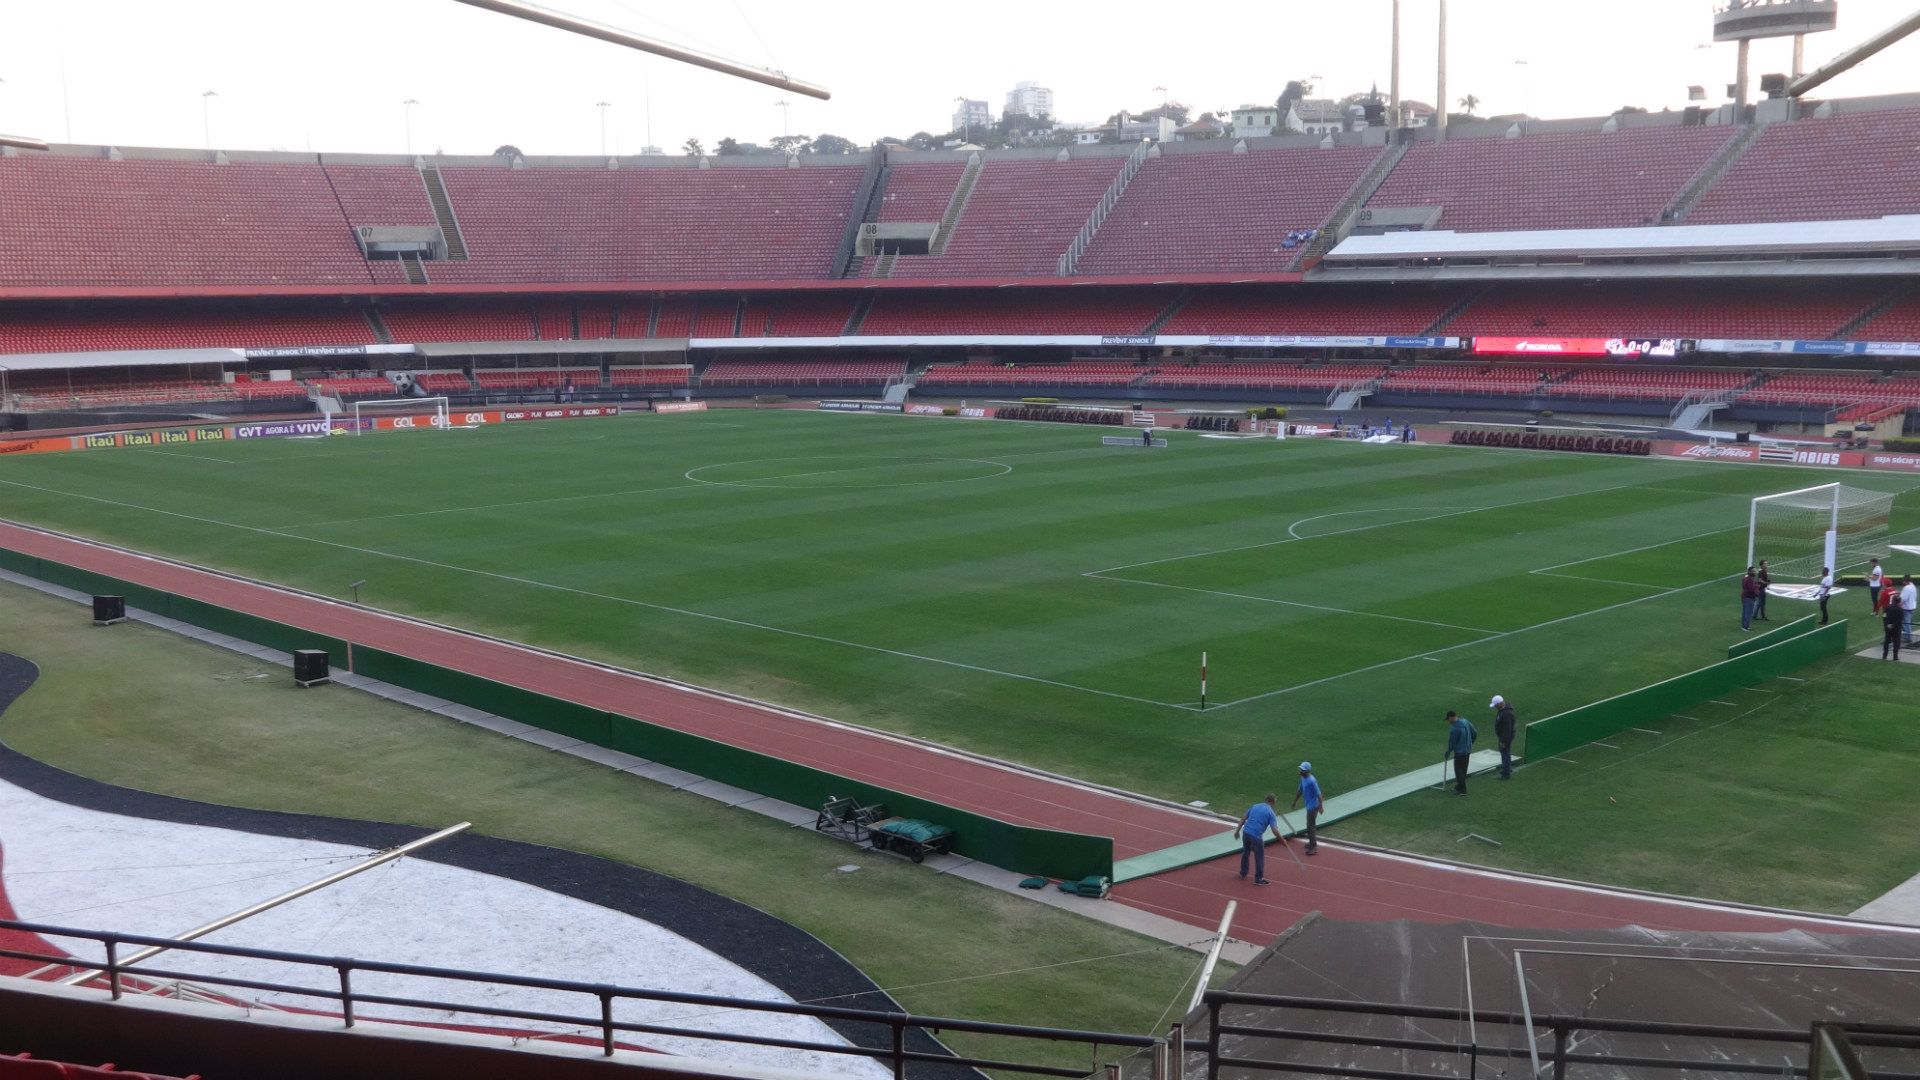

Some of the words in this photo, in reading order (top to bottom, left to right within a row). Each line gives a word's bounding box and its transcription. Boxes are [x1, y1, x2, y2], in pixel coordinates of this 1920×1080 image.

[1360, 210, 1372, 221] 09
[361, 227, 374, 238] 07
[865, 224, 877, 234] 08
[394, 416, 416, 428] GOL
[465, 413, 487, 424] GOL
[239, 426, 262, 437] GVT
[265, 426, 289, 435] AGORA
[86, 435, 115, 448] Itaú
[124, 433, 152, 445] Itaú
[161, 430, 188, 443] Itaú
[197, 428, 223, 441] Itaú
